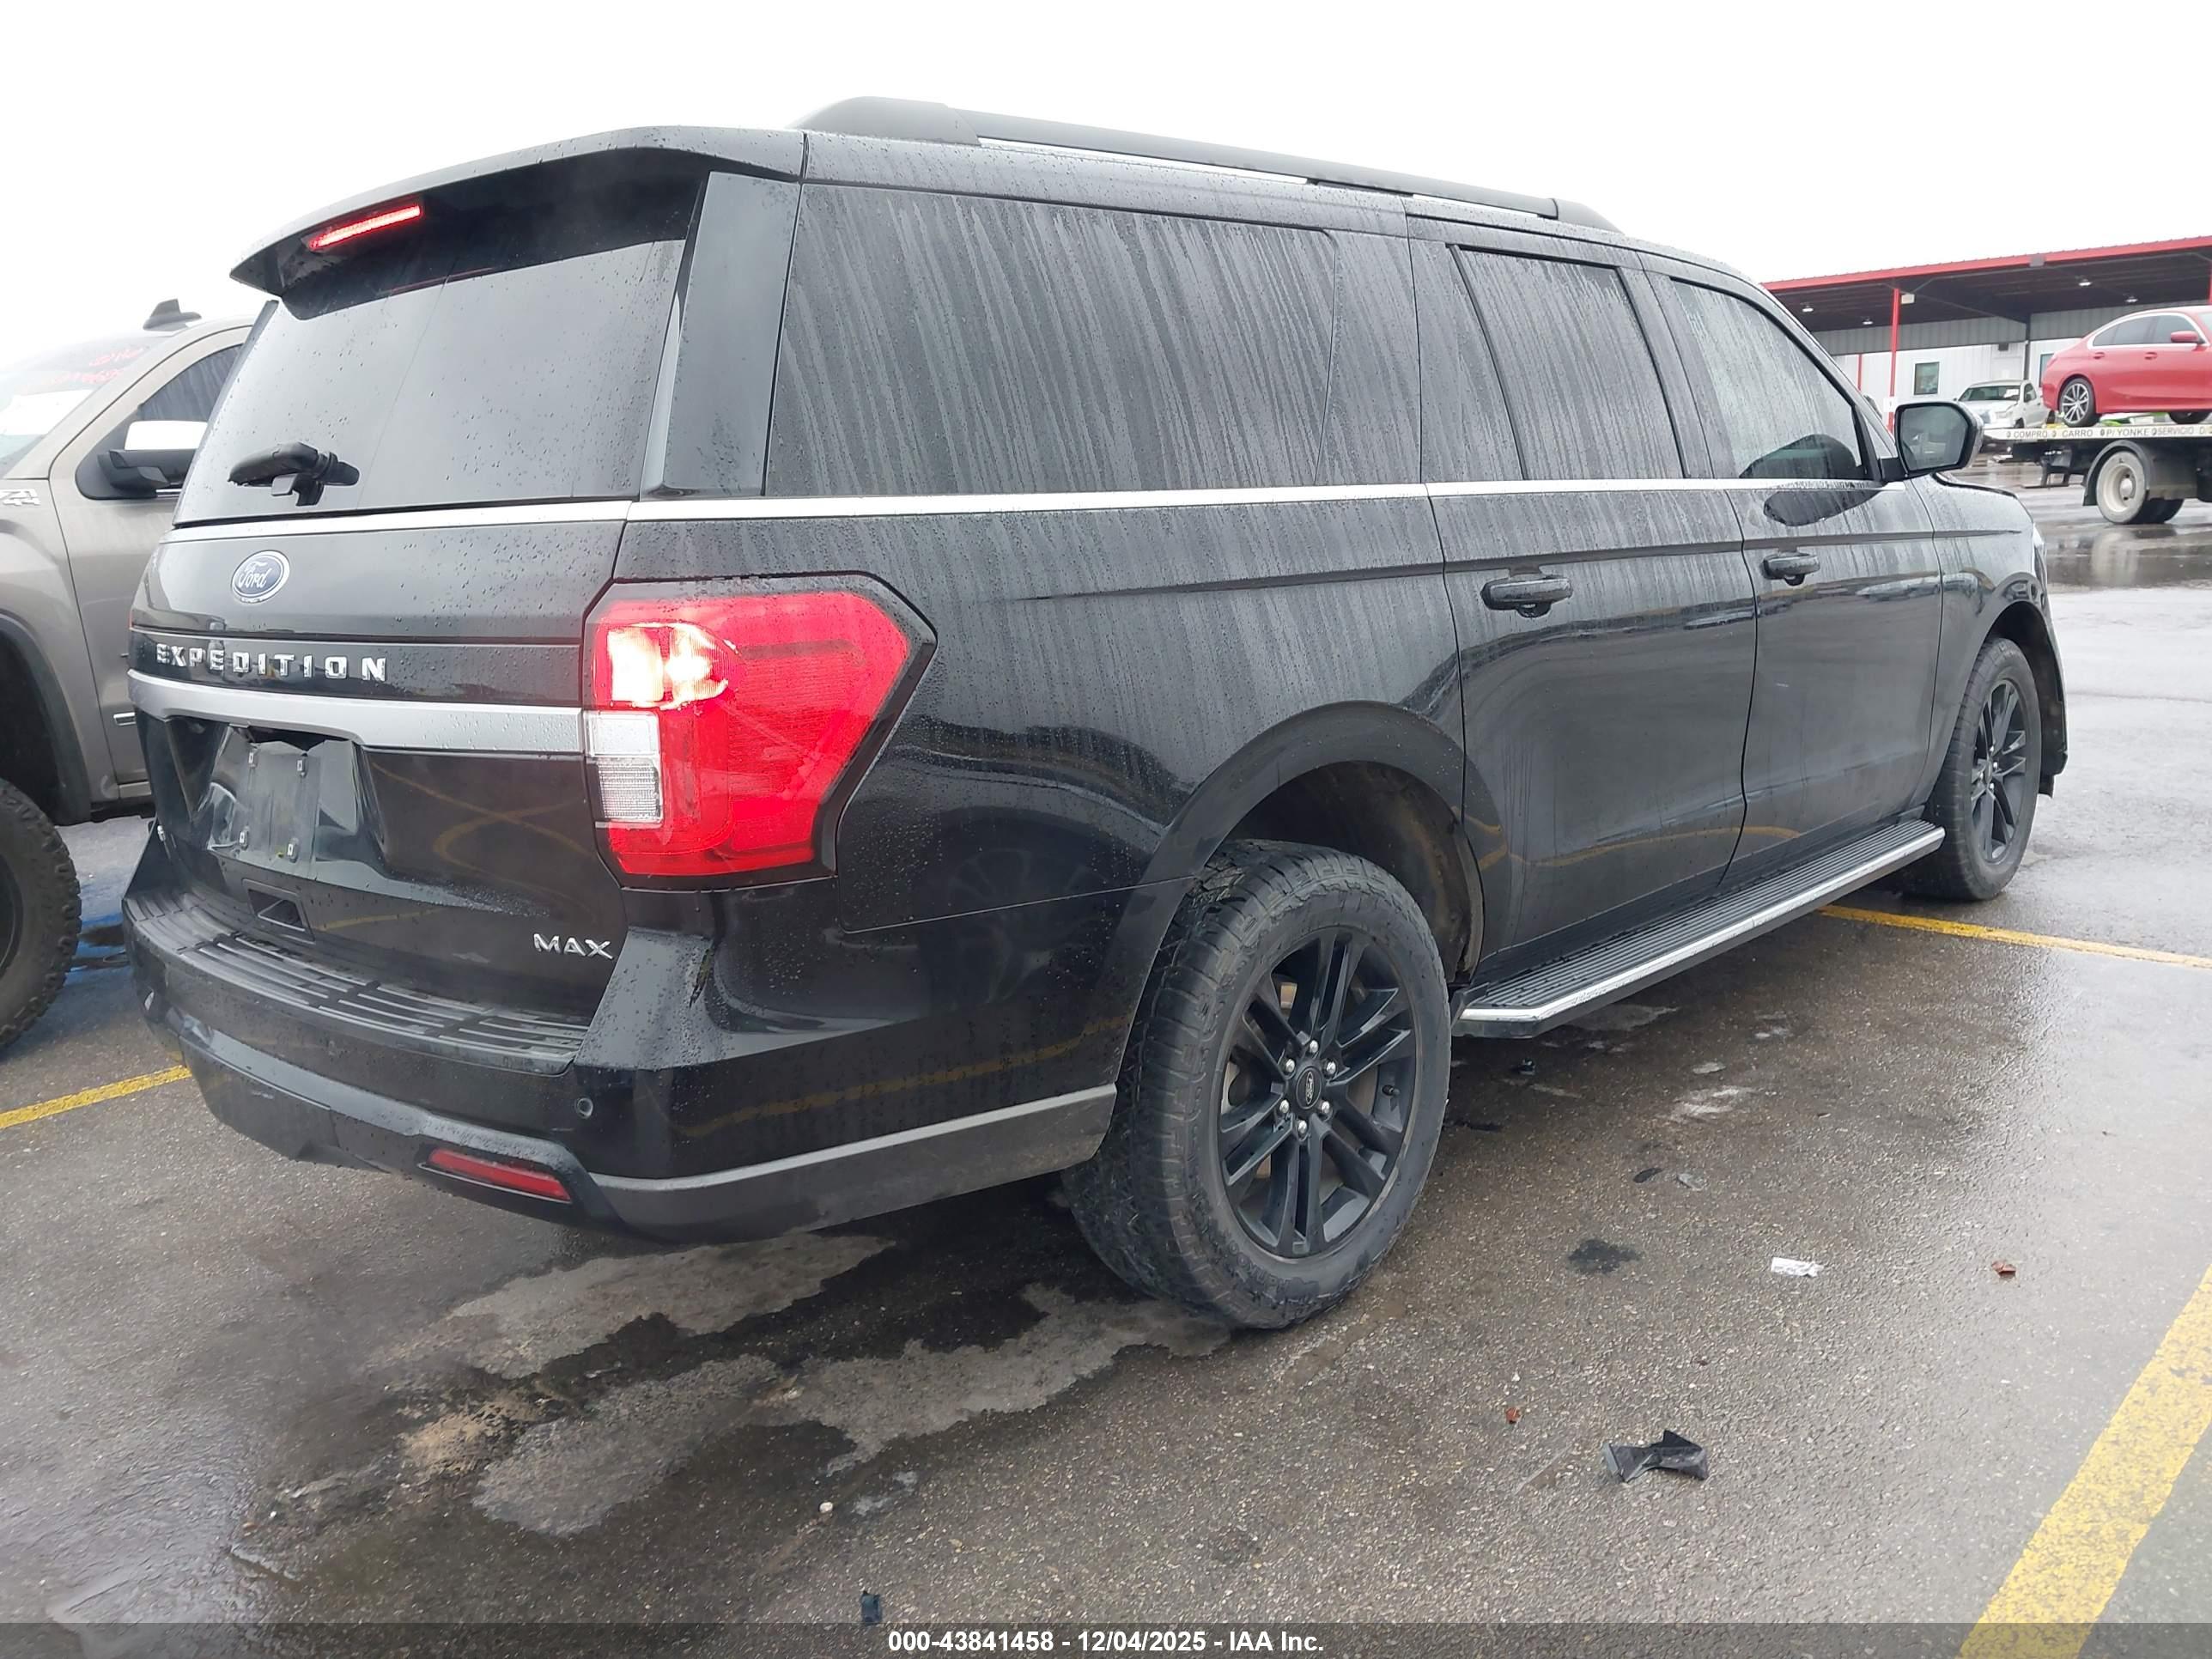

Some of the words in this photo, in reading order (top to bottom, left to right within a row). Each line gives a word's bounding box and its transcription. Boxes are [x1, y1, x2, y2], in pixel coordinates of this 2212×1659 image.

[2014, 430, 2047, 439] COMPRO
[2062, 429, 2093, 438] CARRO
[156, 643, 386, 681] EXPEDITION
[533, 933, 613, 959] MAX
